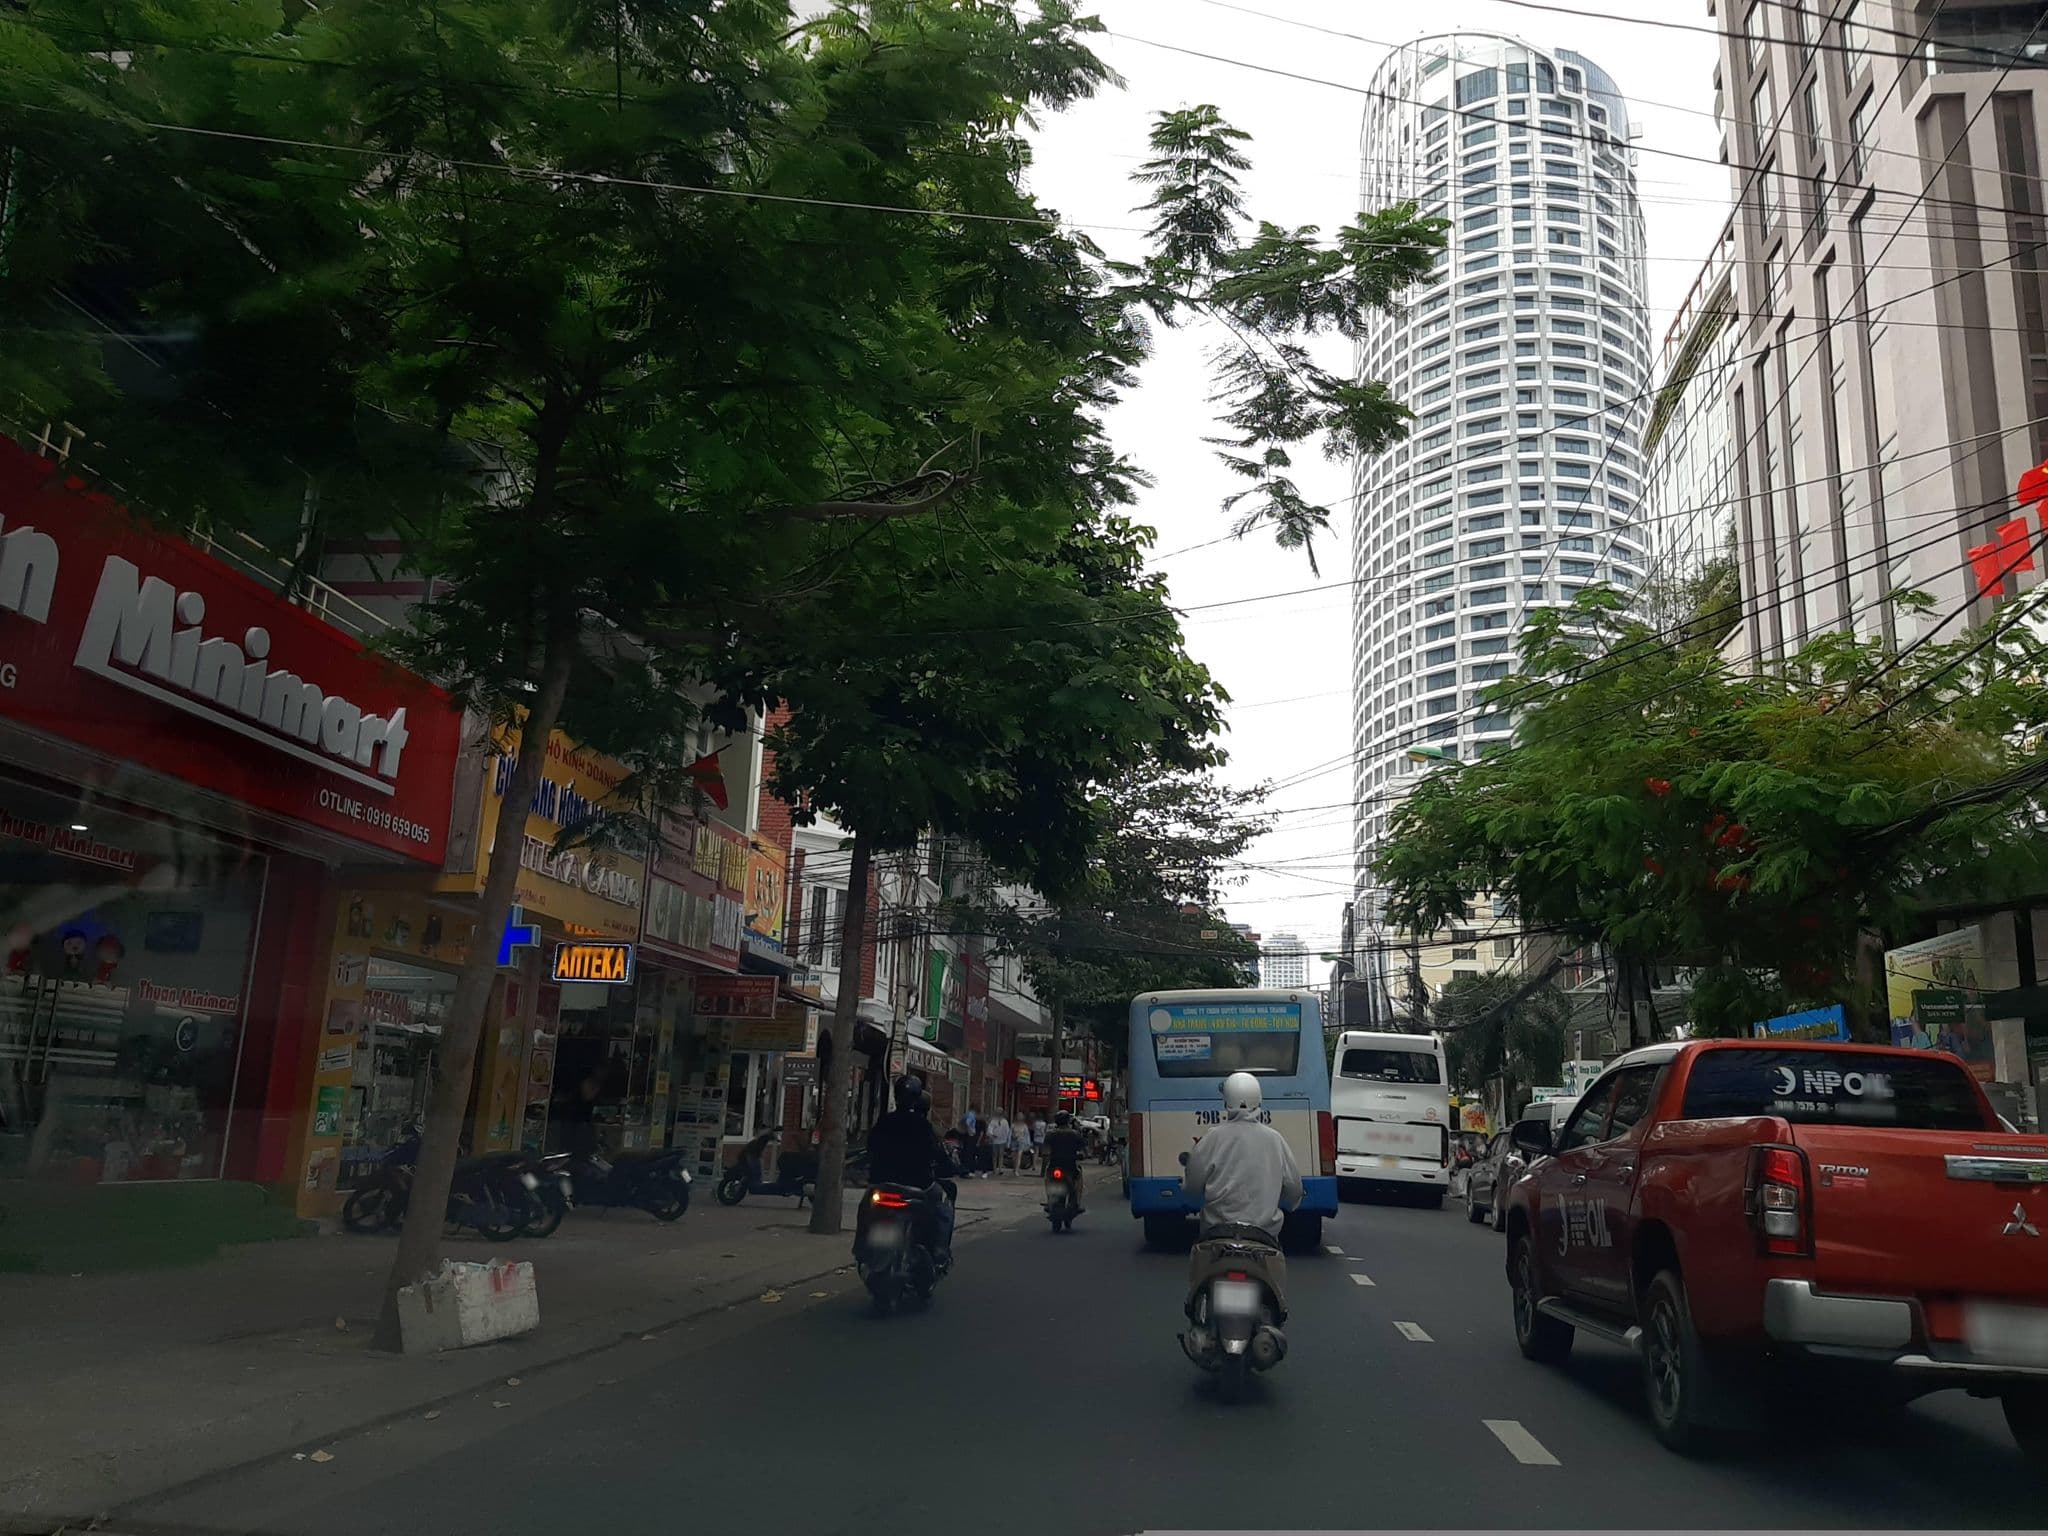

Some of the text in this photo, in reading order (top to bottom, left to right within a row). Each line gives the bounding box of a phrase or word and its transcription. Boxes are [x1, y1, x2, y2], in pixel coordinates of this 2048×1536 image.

[74, 555, 409, 779] Minimart
[367, 806, 391, 830] 0919
[392, 816, 410, 837] 659
[411, 823, 430, 844] 055
[1818, 1164, 1869, 1177] TRITON
